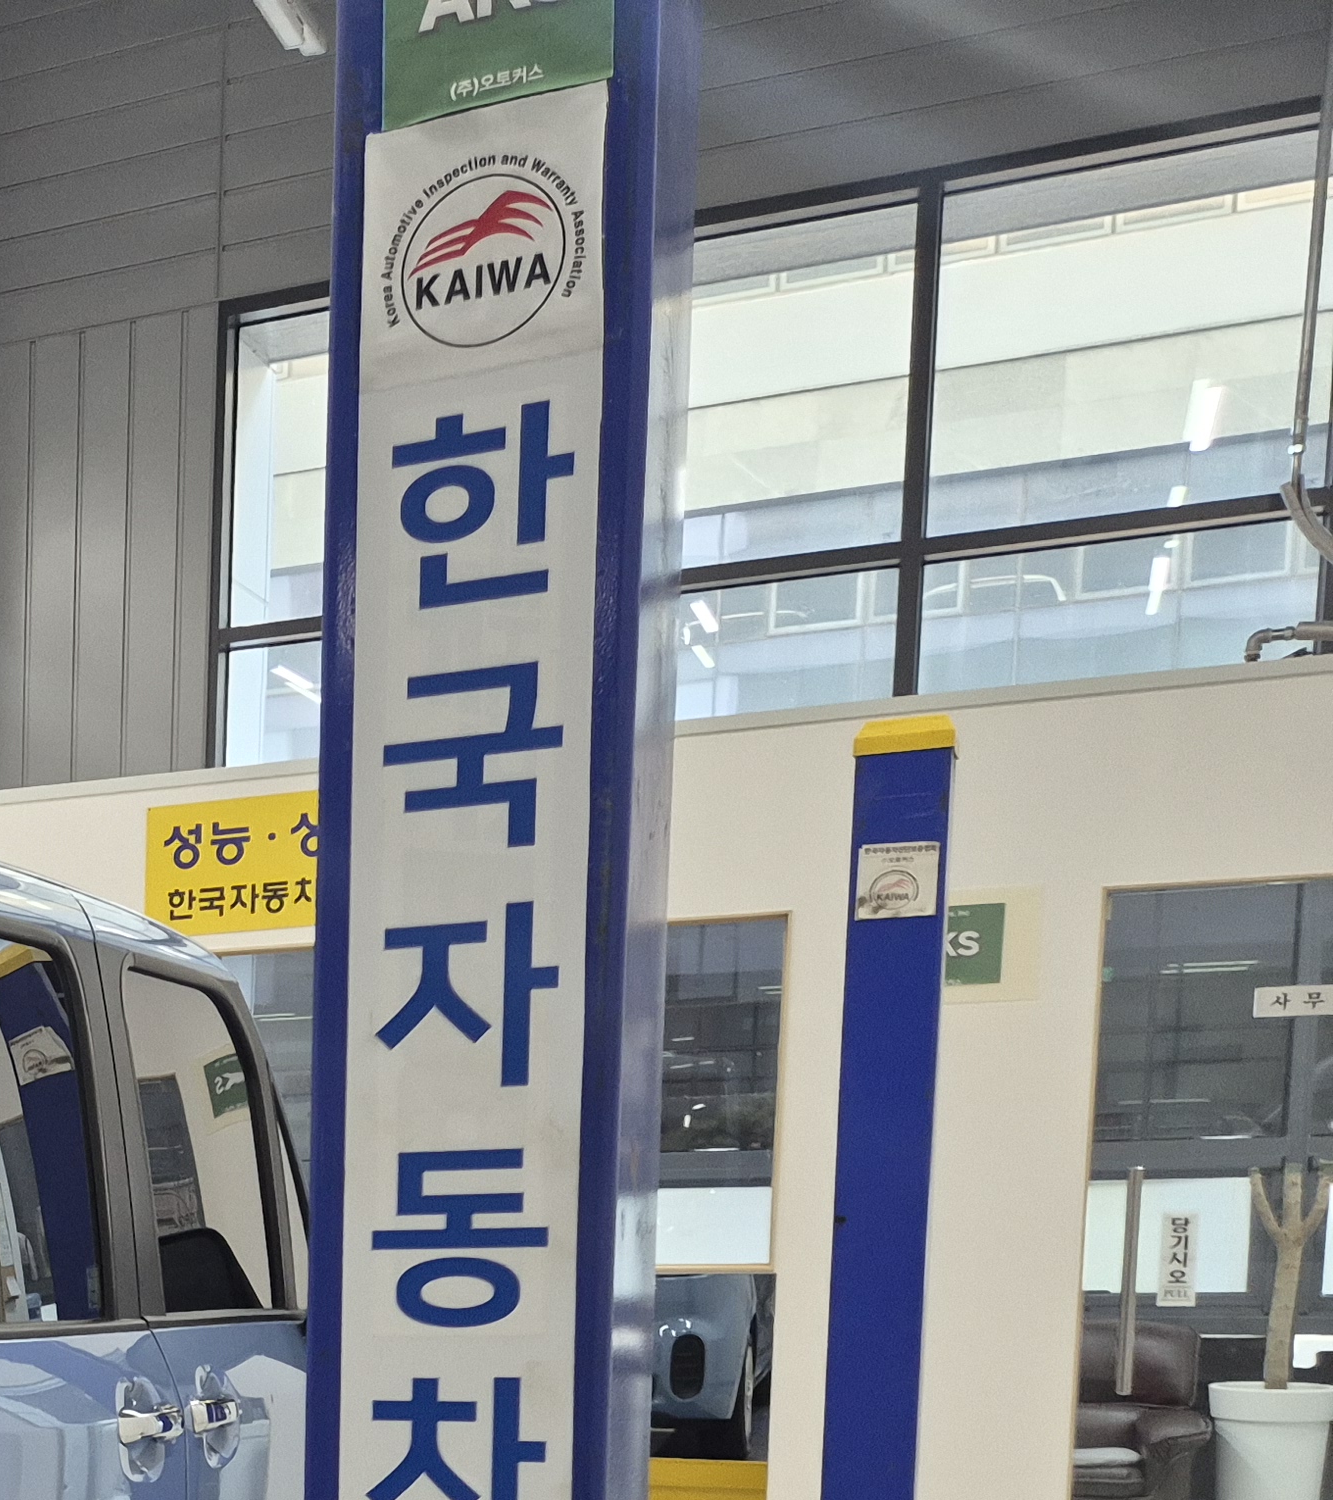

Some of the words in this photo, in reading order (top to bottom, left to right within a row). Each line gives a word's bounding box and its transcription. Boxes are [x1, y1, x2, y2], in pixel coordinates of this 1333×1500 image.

[450, 63, 545, 101] (주)오토커스
[422, 155, 496, 200] Inspection
[500, 154, 529, 169] and
[530, 157, 579, 207] Warranty
[380, 198, 425, 281] Automotive
[561, 209, 587, 298] Association
[383, 284, 401, 328] Korea
[415, 252, 552, 311] KAIWA
[1167, 1217, 1191, 1284] 당기시오
